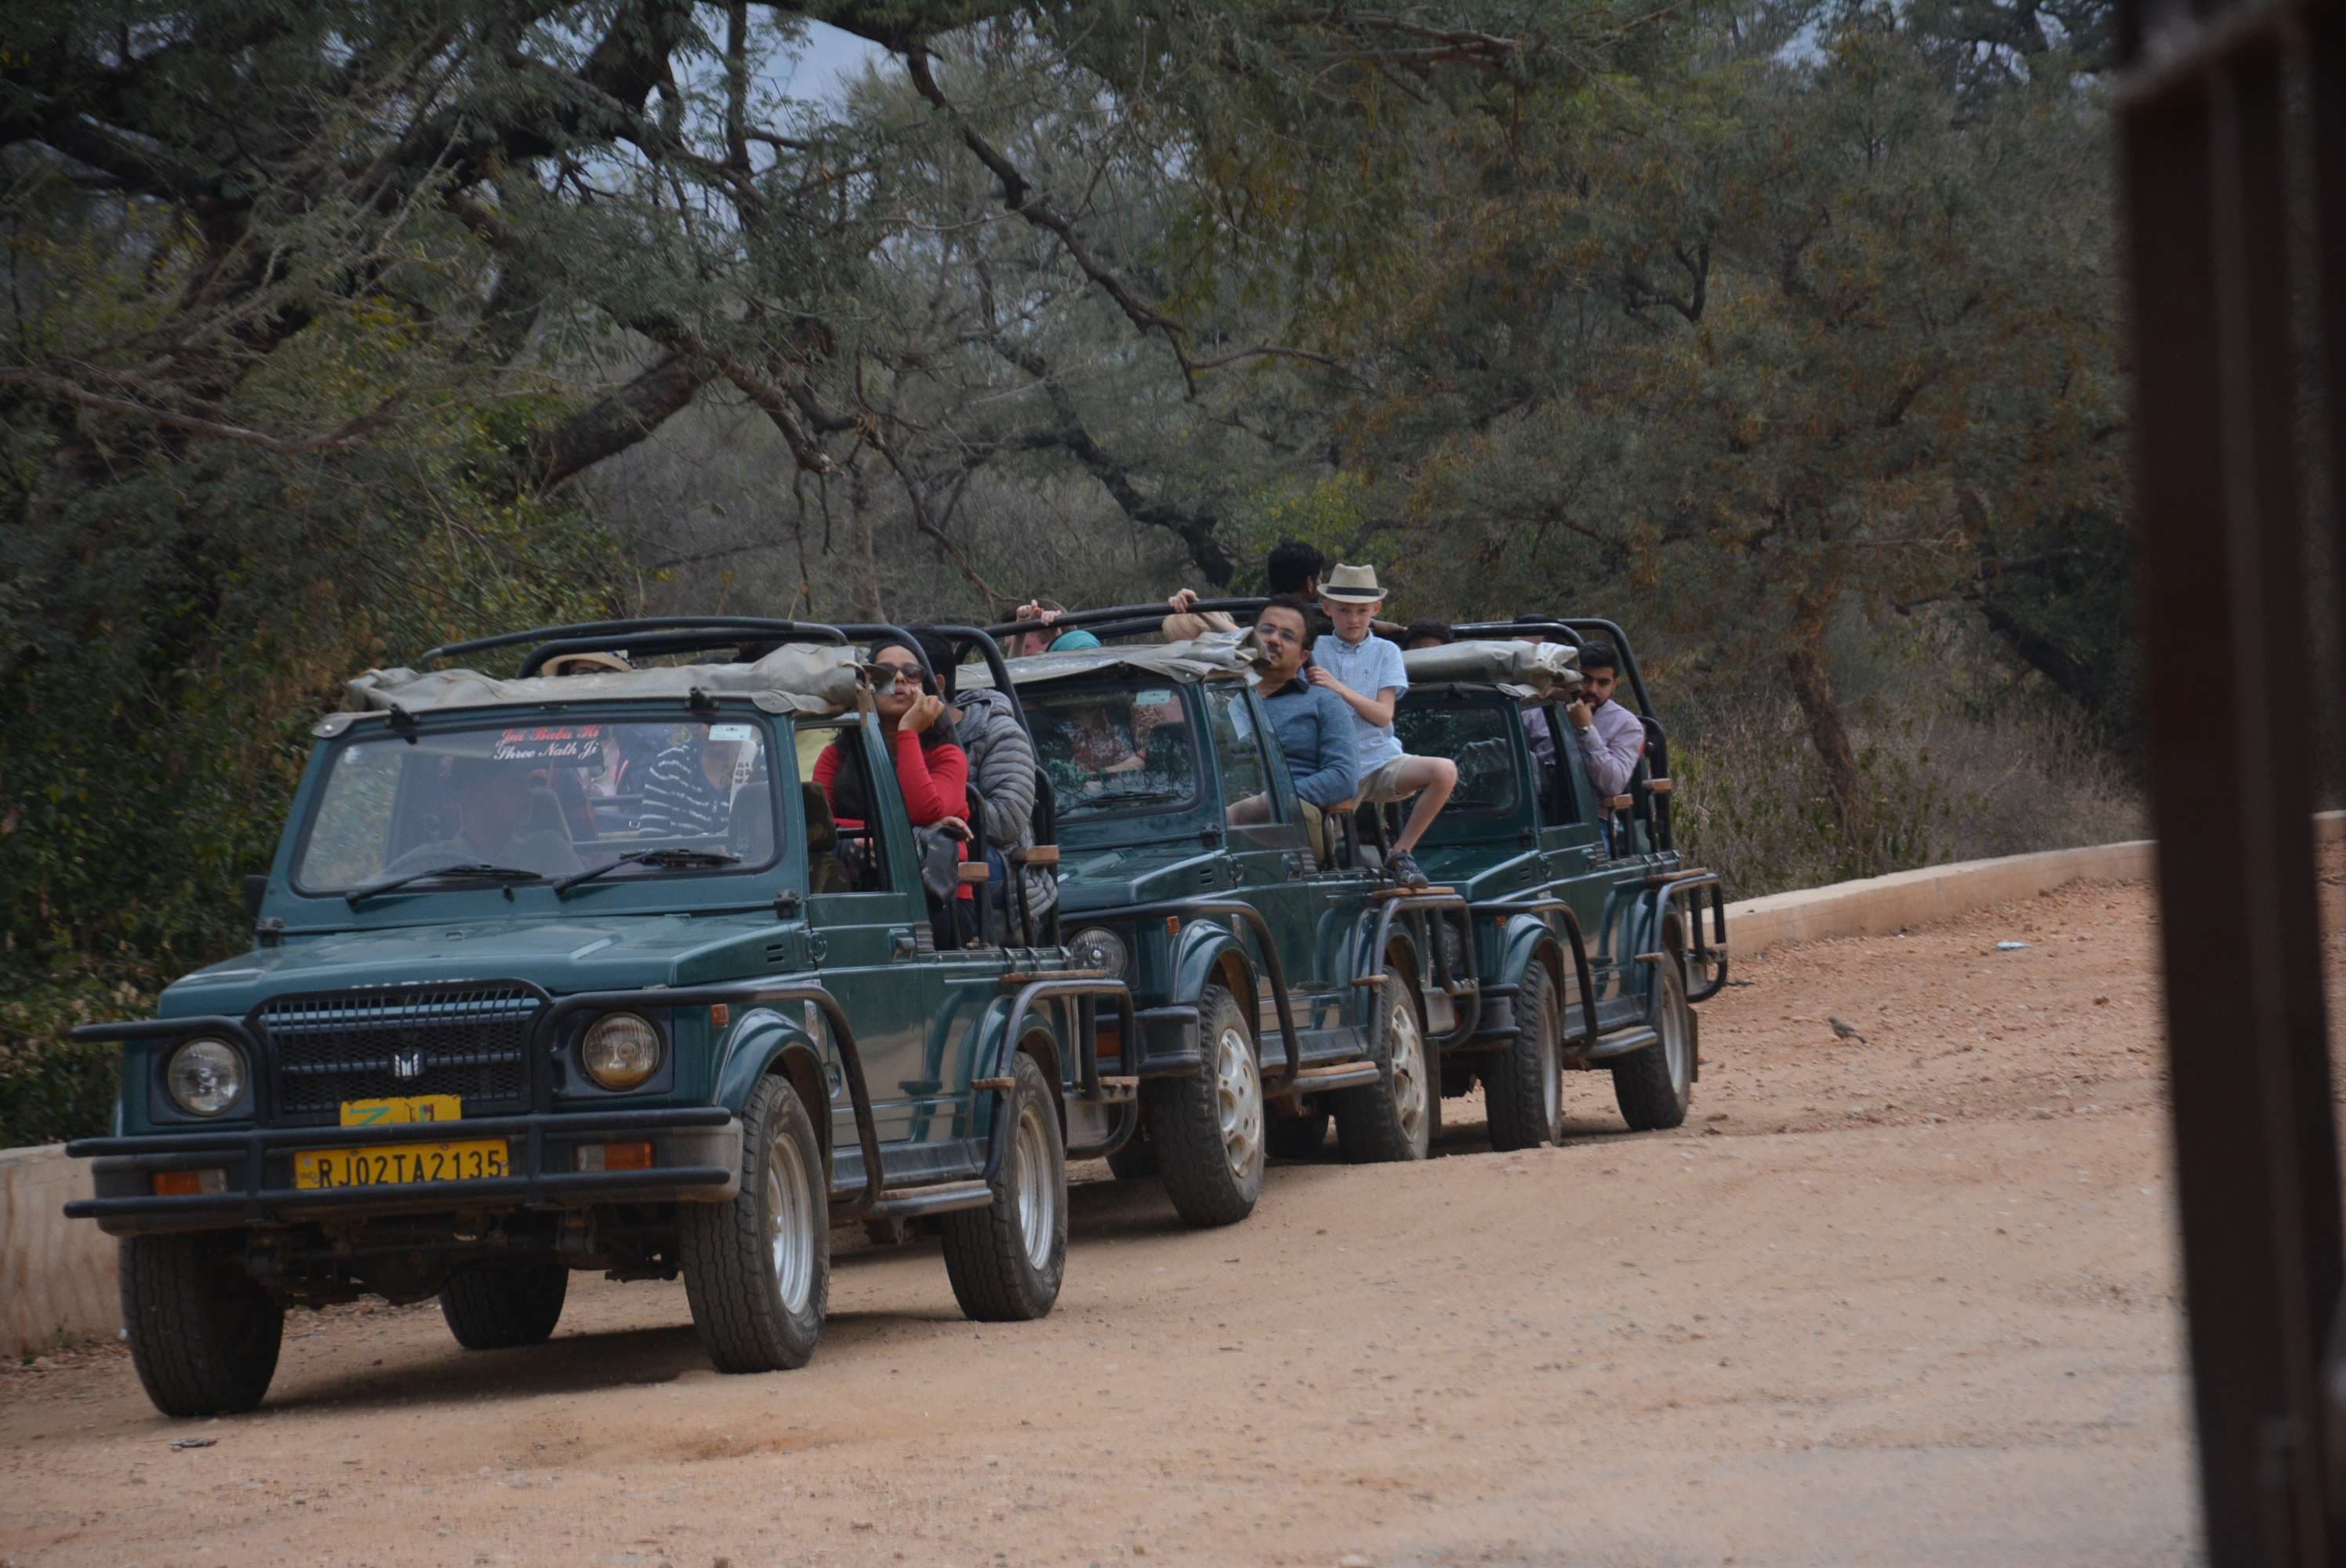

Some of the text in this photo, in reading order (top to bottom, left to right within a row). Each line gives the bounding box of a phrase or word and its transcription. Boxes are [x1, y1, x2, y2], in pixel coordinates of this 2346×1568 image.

[493, 740, 599, 760] Shree Nath Ji
[318, 1149, 502, 1189] RJ02TA2135
